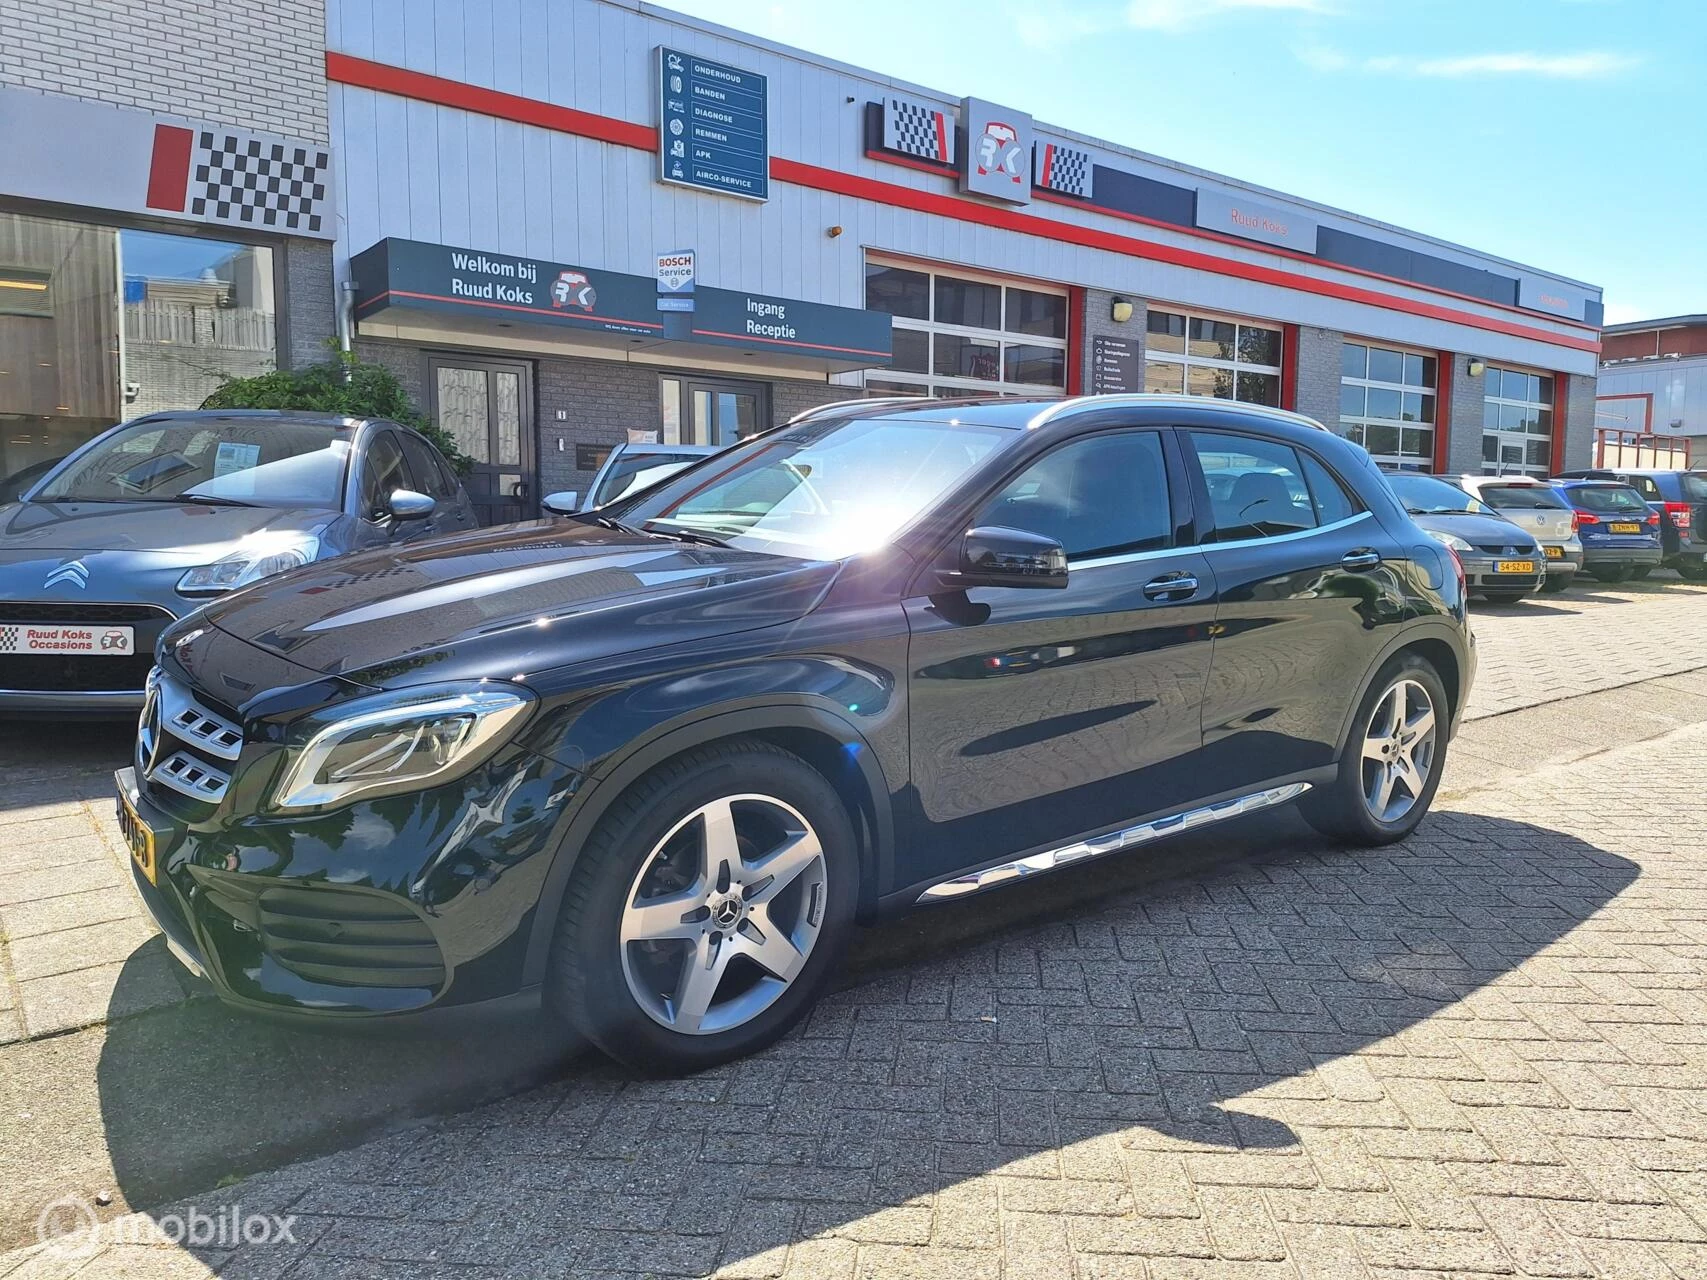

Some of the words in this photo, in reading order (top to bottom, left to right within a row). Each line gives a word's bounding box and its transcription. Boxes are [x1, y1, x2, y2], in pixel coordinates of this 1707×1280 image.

[694, 64, 741, 83] ONDERHOUD
[694, 86, 726, 100] BANDEN
[695, 108, 733, 123] DIAGNOSE
[695, 128, 728, 142] REMMEN
[695, 150, 711, 159] APK
[696, 170, 752, 188] AIRCO-SERVICE
[451, 252, 515, 278] Welkom
[517, 262, 537, 284] bij
[659, 256, 692, 267] BOSCH
[659, 268, 692, 277] Service
[451, 278, 493, 300] Ruud
[496, 285, 534, 305] Koks
[746, 297, 786, 320] Ingang
[746, 319, 796, 340] Receptie
[26, 629, 59, 640] Ruud
[62, 629, 93, 640] Koks
[28, 639, 93, 650] Occasions
